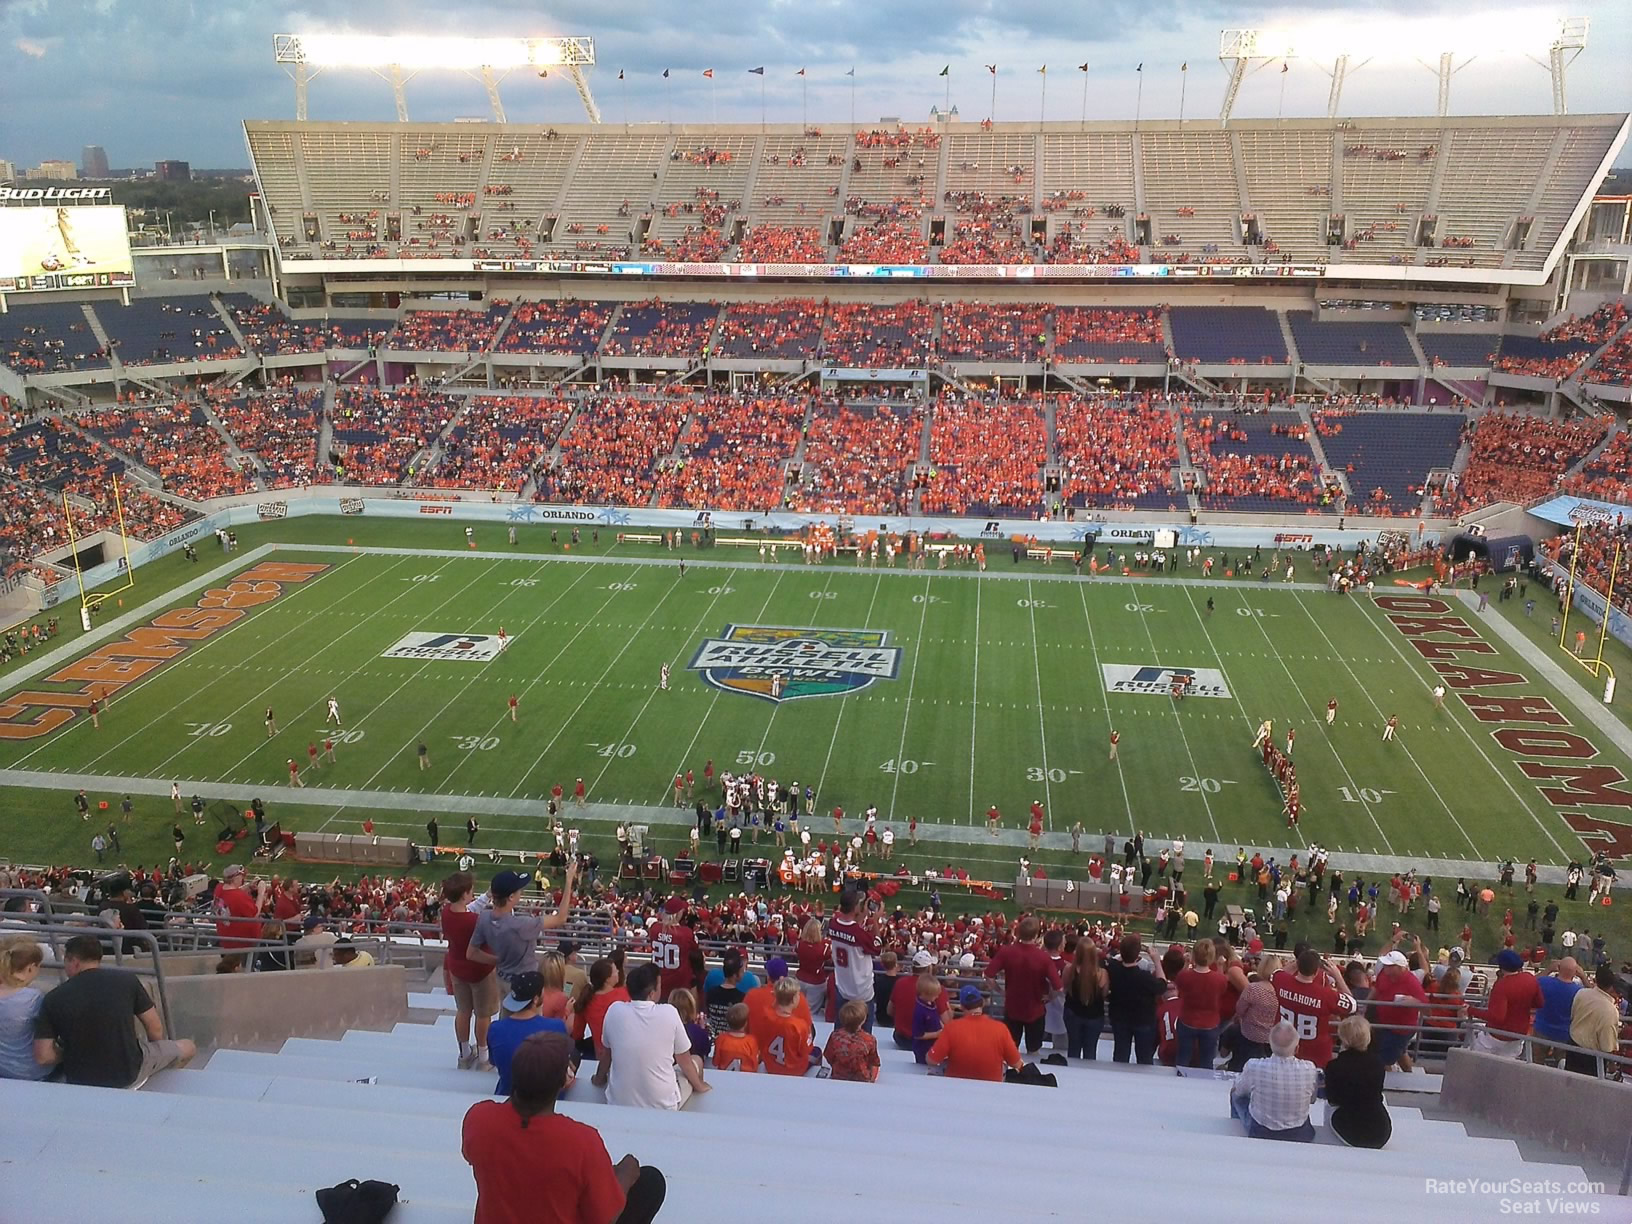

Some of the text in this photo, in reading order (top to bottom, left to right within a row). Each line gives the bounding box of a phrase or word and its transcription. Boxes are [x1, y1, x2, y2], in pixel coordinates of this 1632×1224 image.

[420, 505, 452, 515] ESPN
[542, 510, 595, 520] ORLANDO
[168, 528, 199, 547] ORLANDO
[707, 645, 886, 662] RUSSELL
[706, 654, 889, 670] ATHLETIC
[738, 666, 842, 678] BOWL
[187, 722, 232, 737] 10
[457, 736, 500, 751] 30
[597, 743, 637, 758] 40
[735, 750, 776, 767] 50
[879, 759, 919, 774] 40
[1026, 767, 1067, 783] 30
[1337, 786, 1383, 803] 10
[658, 932, 673, 943] SIMS
[652, 940, 680, 969] 20
[1279, 988, 1322, 1009] OKLAHOMA
[768, 1035, 786, 1066] 4
